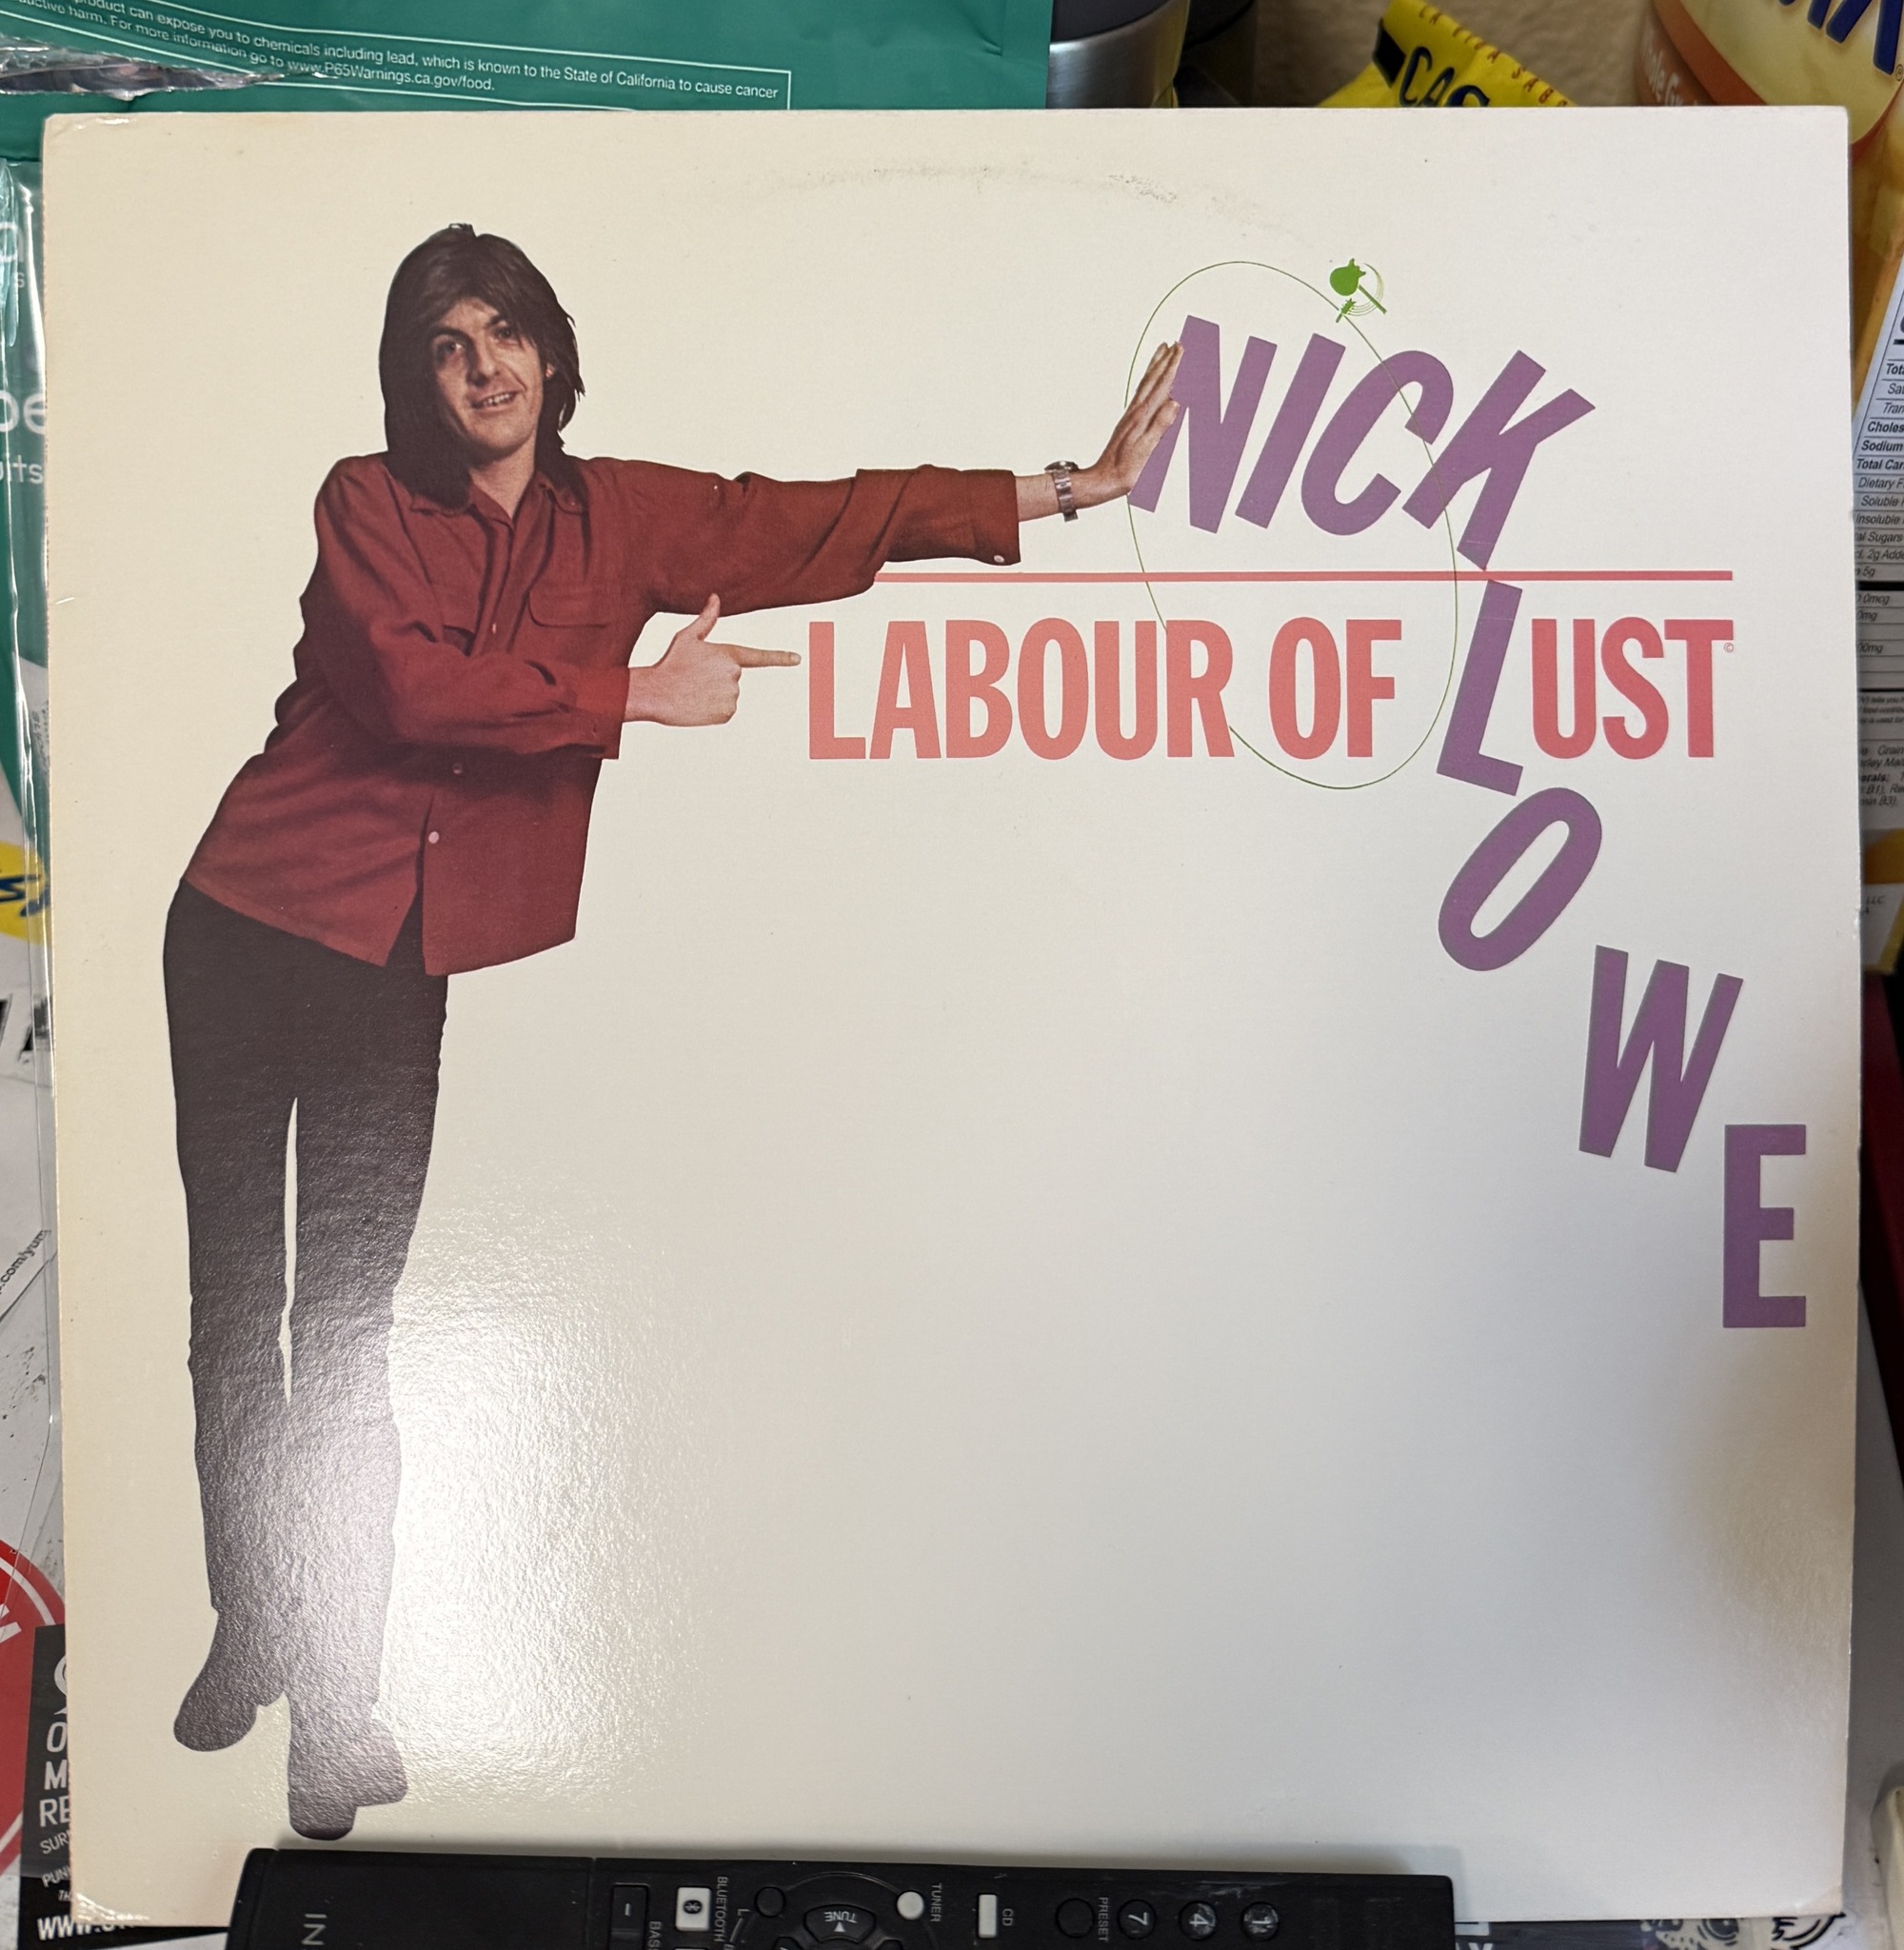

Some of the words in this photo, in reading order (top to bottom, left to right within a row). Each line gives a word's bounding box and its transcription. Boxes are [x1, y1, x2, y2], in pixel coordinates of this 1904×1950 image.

[69, 6, 108, 25] harm.
[110, 14, 131, 30] For
[135, 24, 169, 41] more
[172, 31, 248, 58] information
[250, 52, 268, 66] go
[270, 56, 284, 68] to
[288, 61, 495, 90] www.P65Warnings.ca.gov/food.
[129, 7, 155, 21] can
[157, 14, 206, 34] expose
[208, 27, 233, 40] you
[237, 31, 250, 44] to
[254, 36, 321, 56] chemicals
[324, 47, 383, 65] including
[387, 50, 419, 67] lead,
[422, 55, 461, 70] which
[464, 61, 475, 71] is
[478, 59, 521, 74] known
[525, 65, 537, 77] to
[541, 66, 561, 79] the
[564, 67, 598, 83] State
[601, 70, 614, 84] of
[617, 71, 676, 90] California
[679, 79, 692, 91] to
[695, 81, 732, 95] cause
[735, 85, 779, 99] cancer
[1127, 315, 1596, 569] NICK
[1861, 440, 1903, 452] Sodium
[1856, 458, 1882, 470] Total
[1858, 477, 1894, 490] Dietary
[1861, 495, 1898, 507] Soluble
[1868, 531, 1902, 544] Sugars
[809, 618, 1235, 760] LABOUR
[1269, 617, 1402, 760] OF
[713, 1876, 728, 1942] BLUETOOTH
[930, 1882, 943, 1922] TUNER
[823, 1910, 859, 1923] TUNE
[1002, 1908, 1014, 1926] CD
[1097, 1897, 1109, 1942] PRESET
[1127, 1911, 1148, 1926] 7
[1189, 1913, 1209, 1927] 4
[1251, 1916, 1273, 1927] 1
